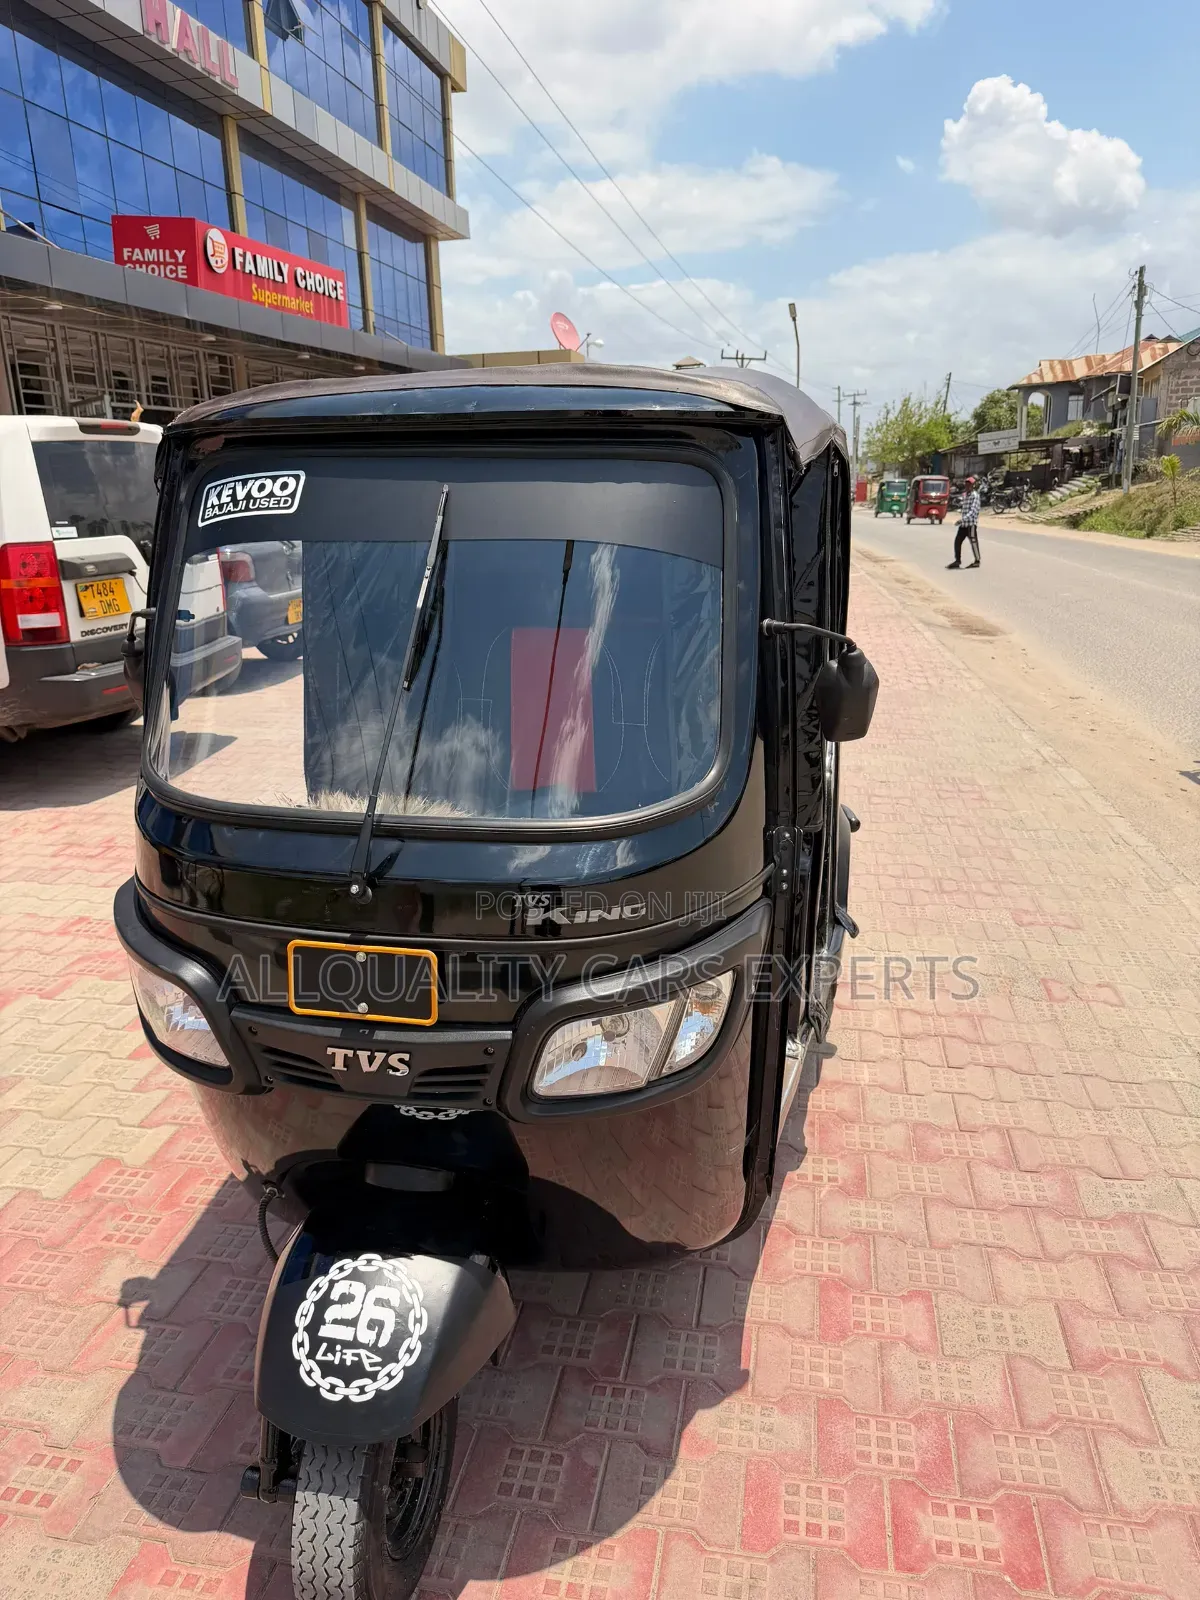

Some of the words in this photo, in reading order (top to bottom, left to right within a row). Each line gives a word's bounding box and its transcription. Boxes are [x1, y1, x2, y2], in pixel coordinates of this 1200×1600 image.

[144, 0, 239, 89] HALL
[123, 247, 186, 263] FAMILY
[233, 246, 289, 284] FAMILY
[295, 266, 344, 301] CHOICE
[251, 283, 314, 314] Supermarket
[206, 476, 297, 508] KEVOO
[204, 500, 247, 519] BAJAJI
[249, 497, 292, 509] USED
[90, 582, 115, 598] T484
[99, 598, 121, 614] DMG
[81, 623, 128, 637] DISCOVERY
[512, 894, 551, 907] TVS
[326, 1046, 411, 1077] TVS
[318, 1280, 401, 1347] 26
